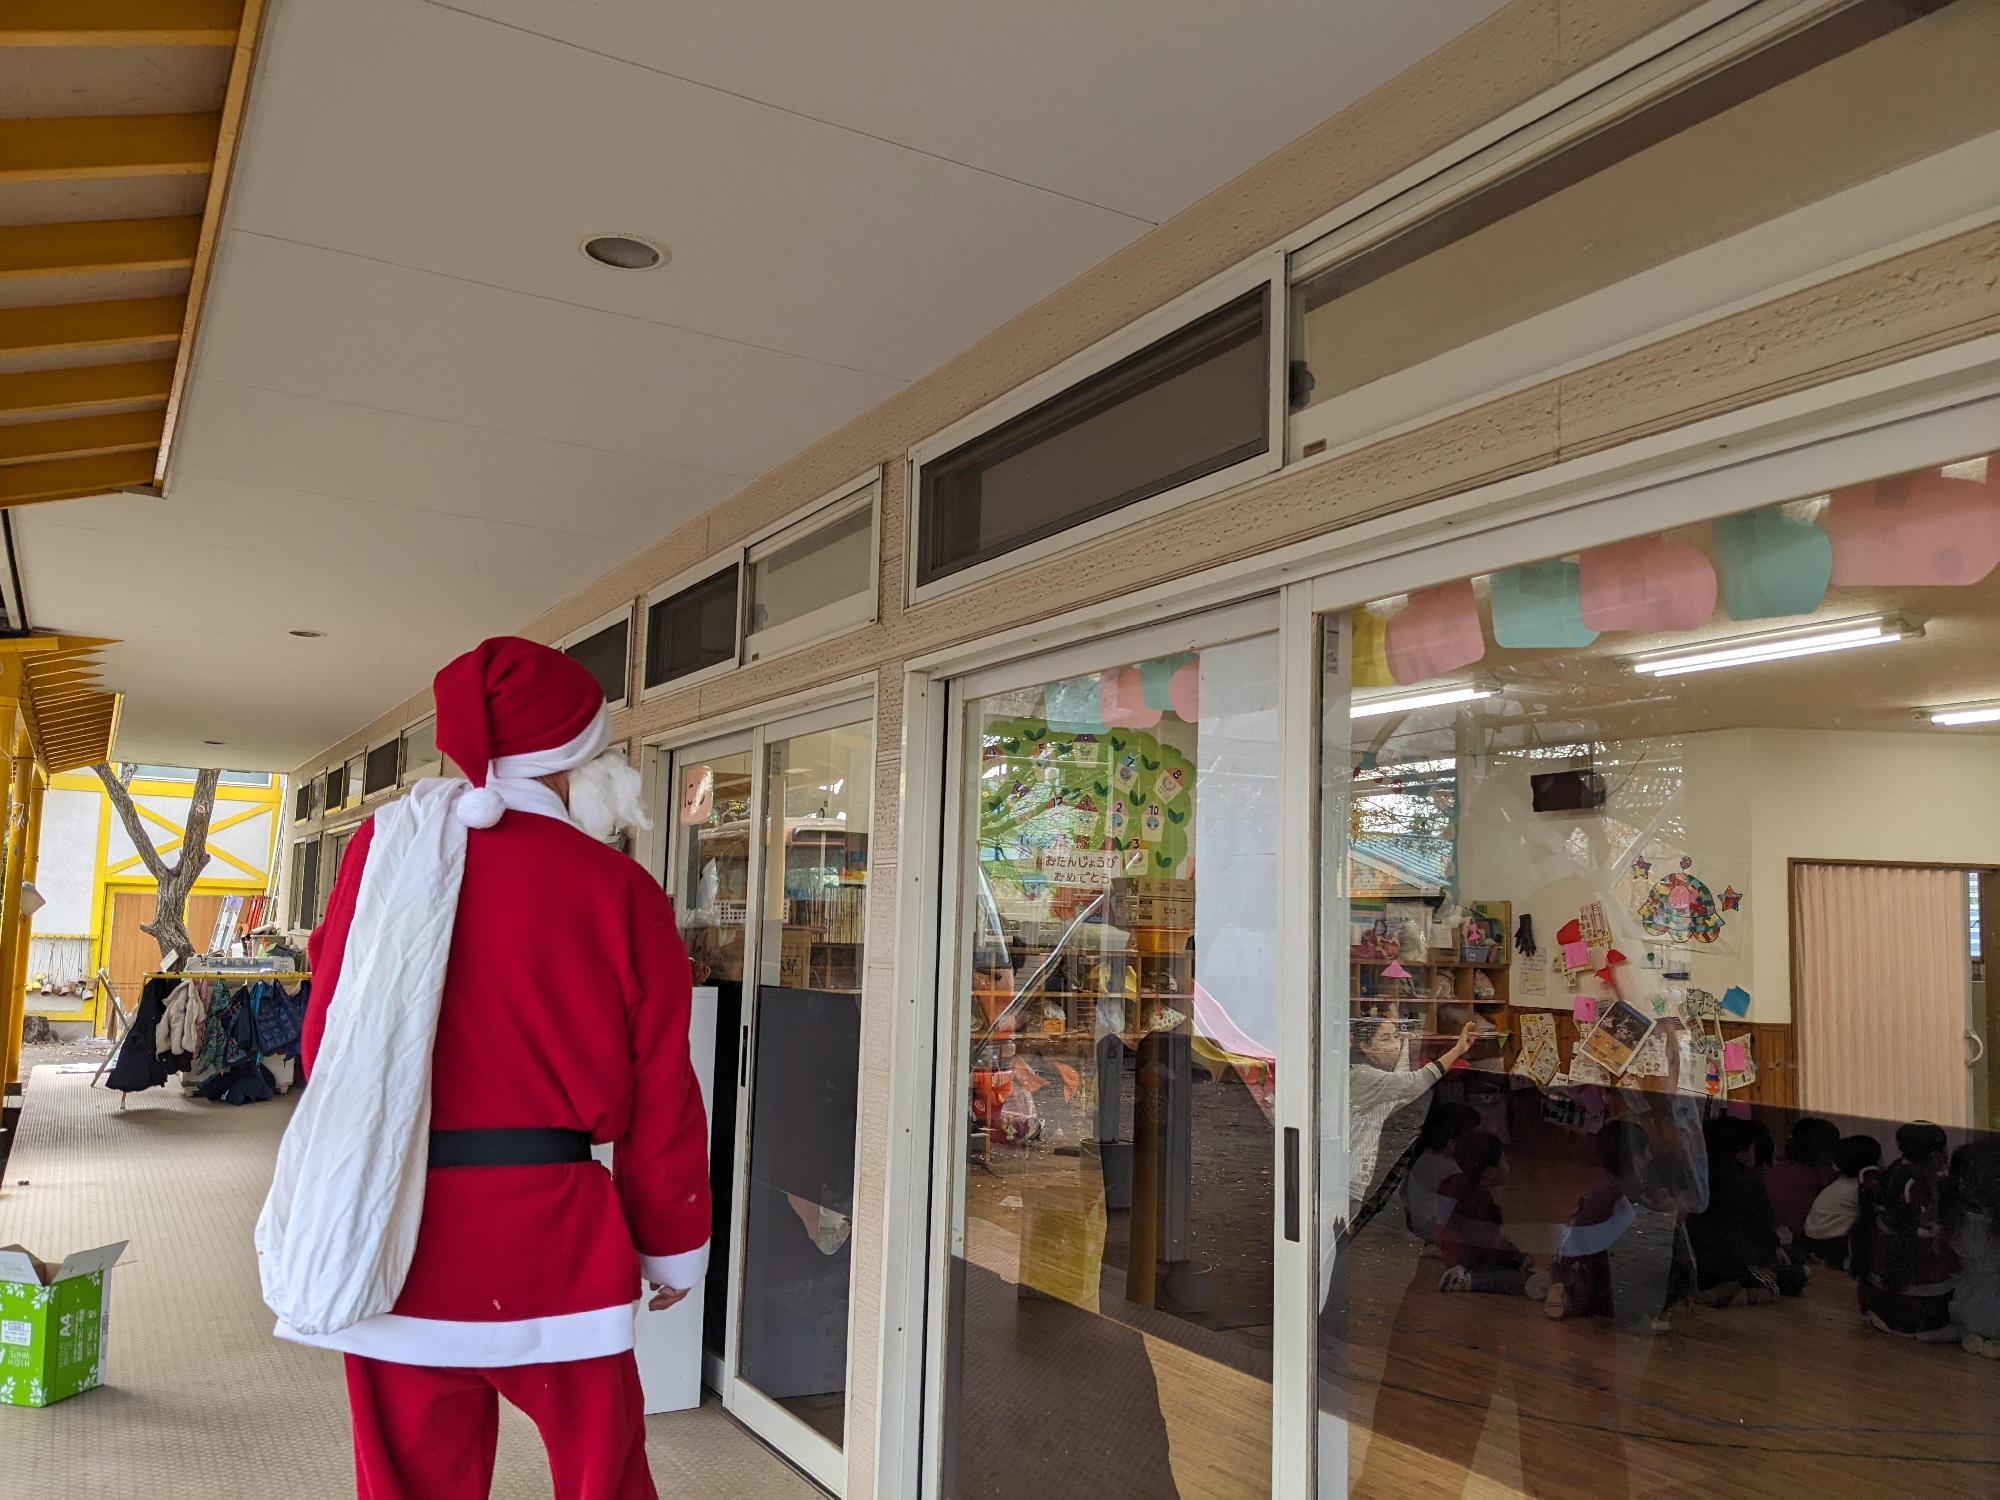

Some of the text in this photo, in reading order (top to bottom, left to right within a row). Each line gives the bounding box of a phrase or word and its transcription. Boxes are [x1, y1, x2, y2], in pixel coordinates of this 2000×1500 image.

[1127, 756, 1135, 767] 7
[1173, 769, 1182, 779] 8
[1115, 802, 1123, 812] 2
[1148, 804, 1159, 815] 10
[1132, 838, 1140, 849] 3
[1045, 855, 1119, 868] おたんじょうび
[1054, 871, 1110, 885] おめでとう
[60, 1313, 72, 1336] A4
